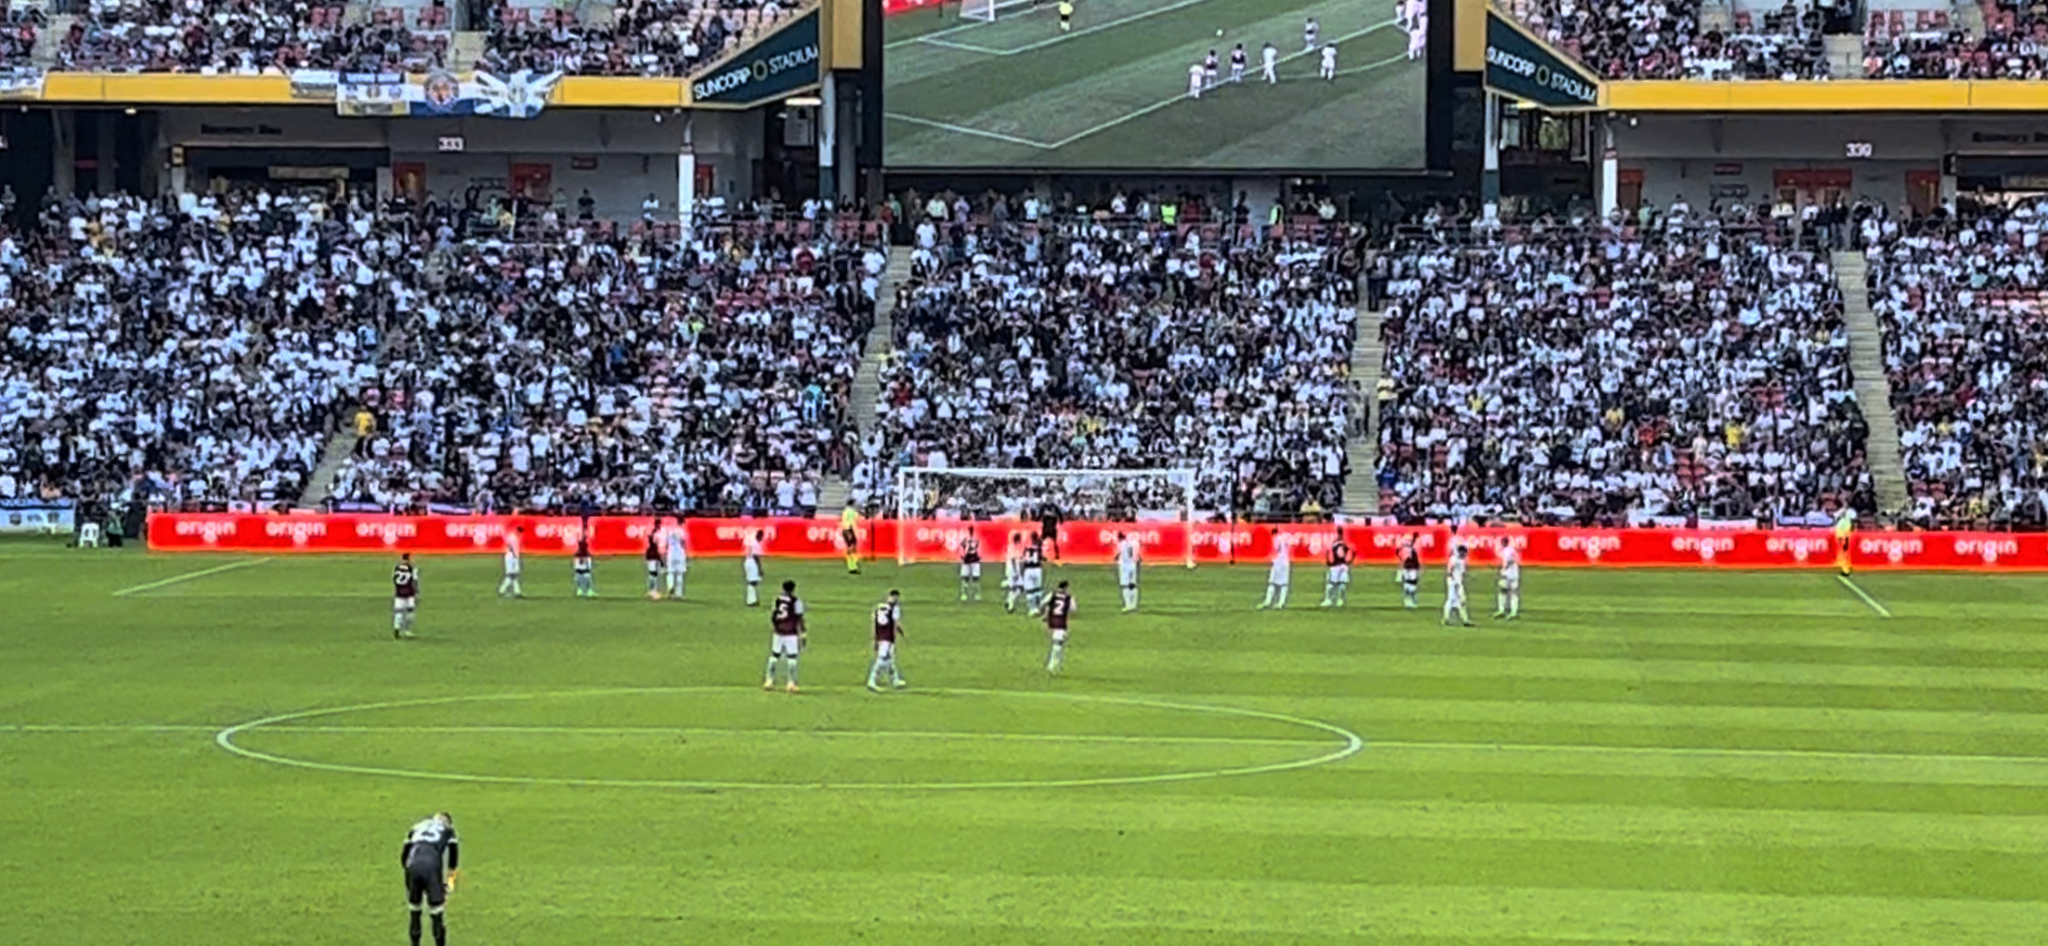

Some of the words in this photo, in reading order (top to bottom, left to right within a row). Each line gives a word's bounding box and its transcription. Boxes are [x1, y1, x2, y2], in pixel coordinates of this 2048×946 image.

[693, 66, 751, 99] SUNCORP
[768, 43, 819, 74] STADIUM
[1486, 45, 1536, 77] SUNCORP
[1550, 71, 1596, 102] STADIUM
[175, 521, 236, 543] origin
[265, 521, 327, 544] origin
[355, 522, 417, 545] origin
[1558, 536, 1620, 559] origin
[1671, 537, 1735, 560] origin
[1766, 538, 1828, 561] origin
[1860, 539, 1923, 563] origin
[1954, 540, 2018, 563] origin
[777, 603, 788, 619] 5
[1053, 600, 1064, 615] 2
